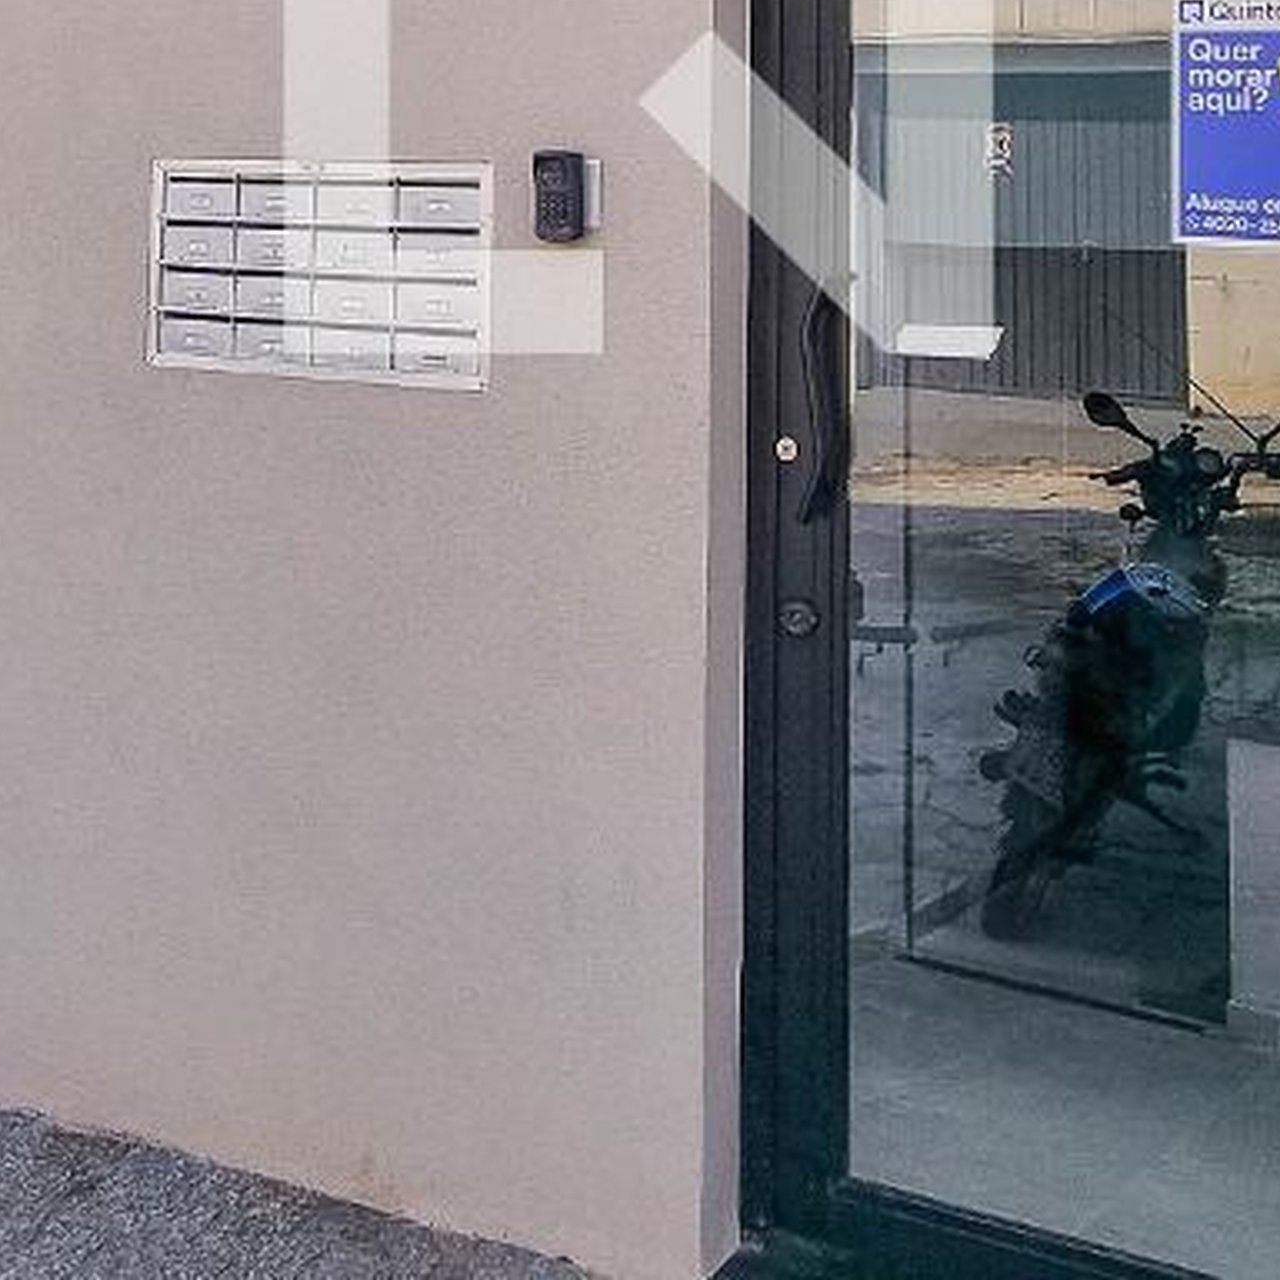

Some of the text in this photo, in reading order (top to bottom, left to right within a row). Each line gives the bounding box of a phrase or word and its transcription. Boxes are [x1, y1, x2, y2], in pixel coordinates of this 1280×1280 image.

[1188, 38, 1264, 63] Quer
[1188, 69, 1278, 88] morar
[1188, 88, 1270, 117] aqui?
[1185, 192, 1260, 213] Alugue
